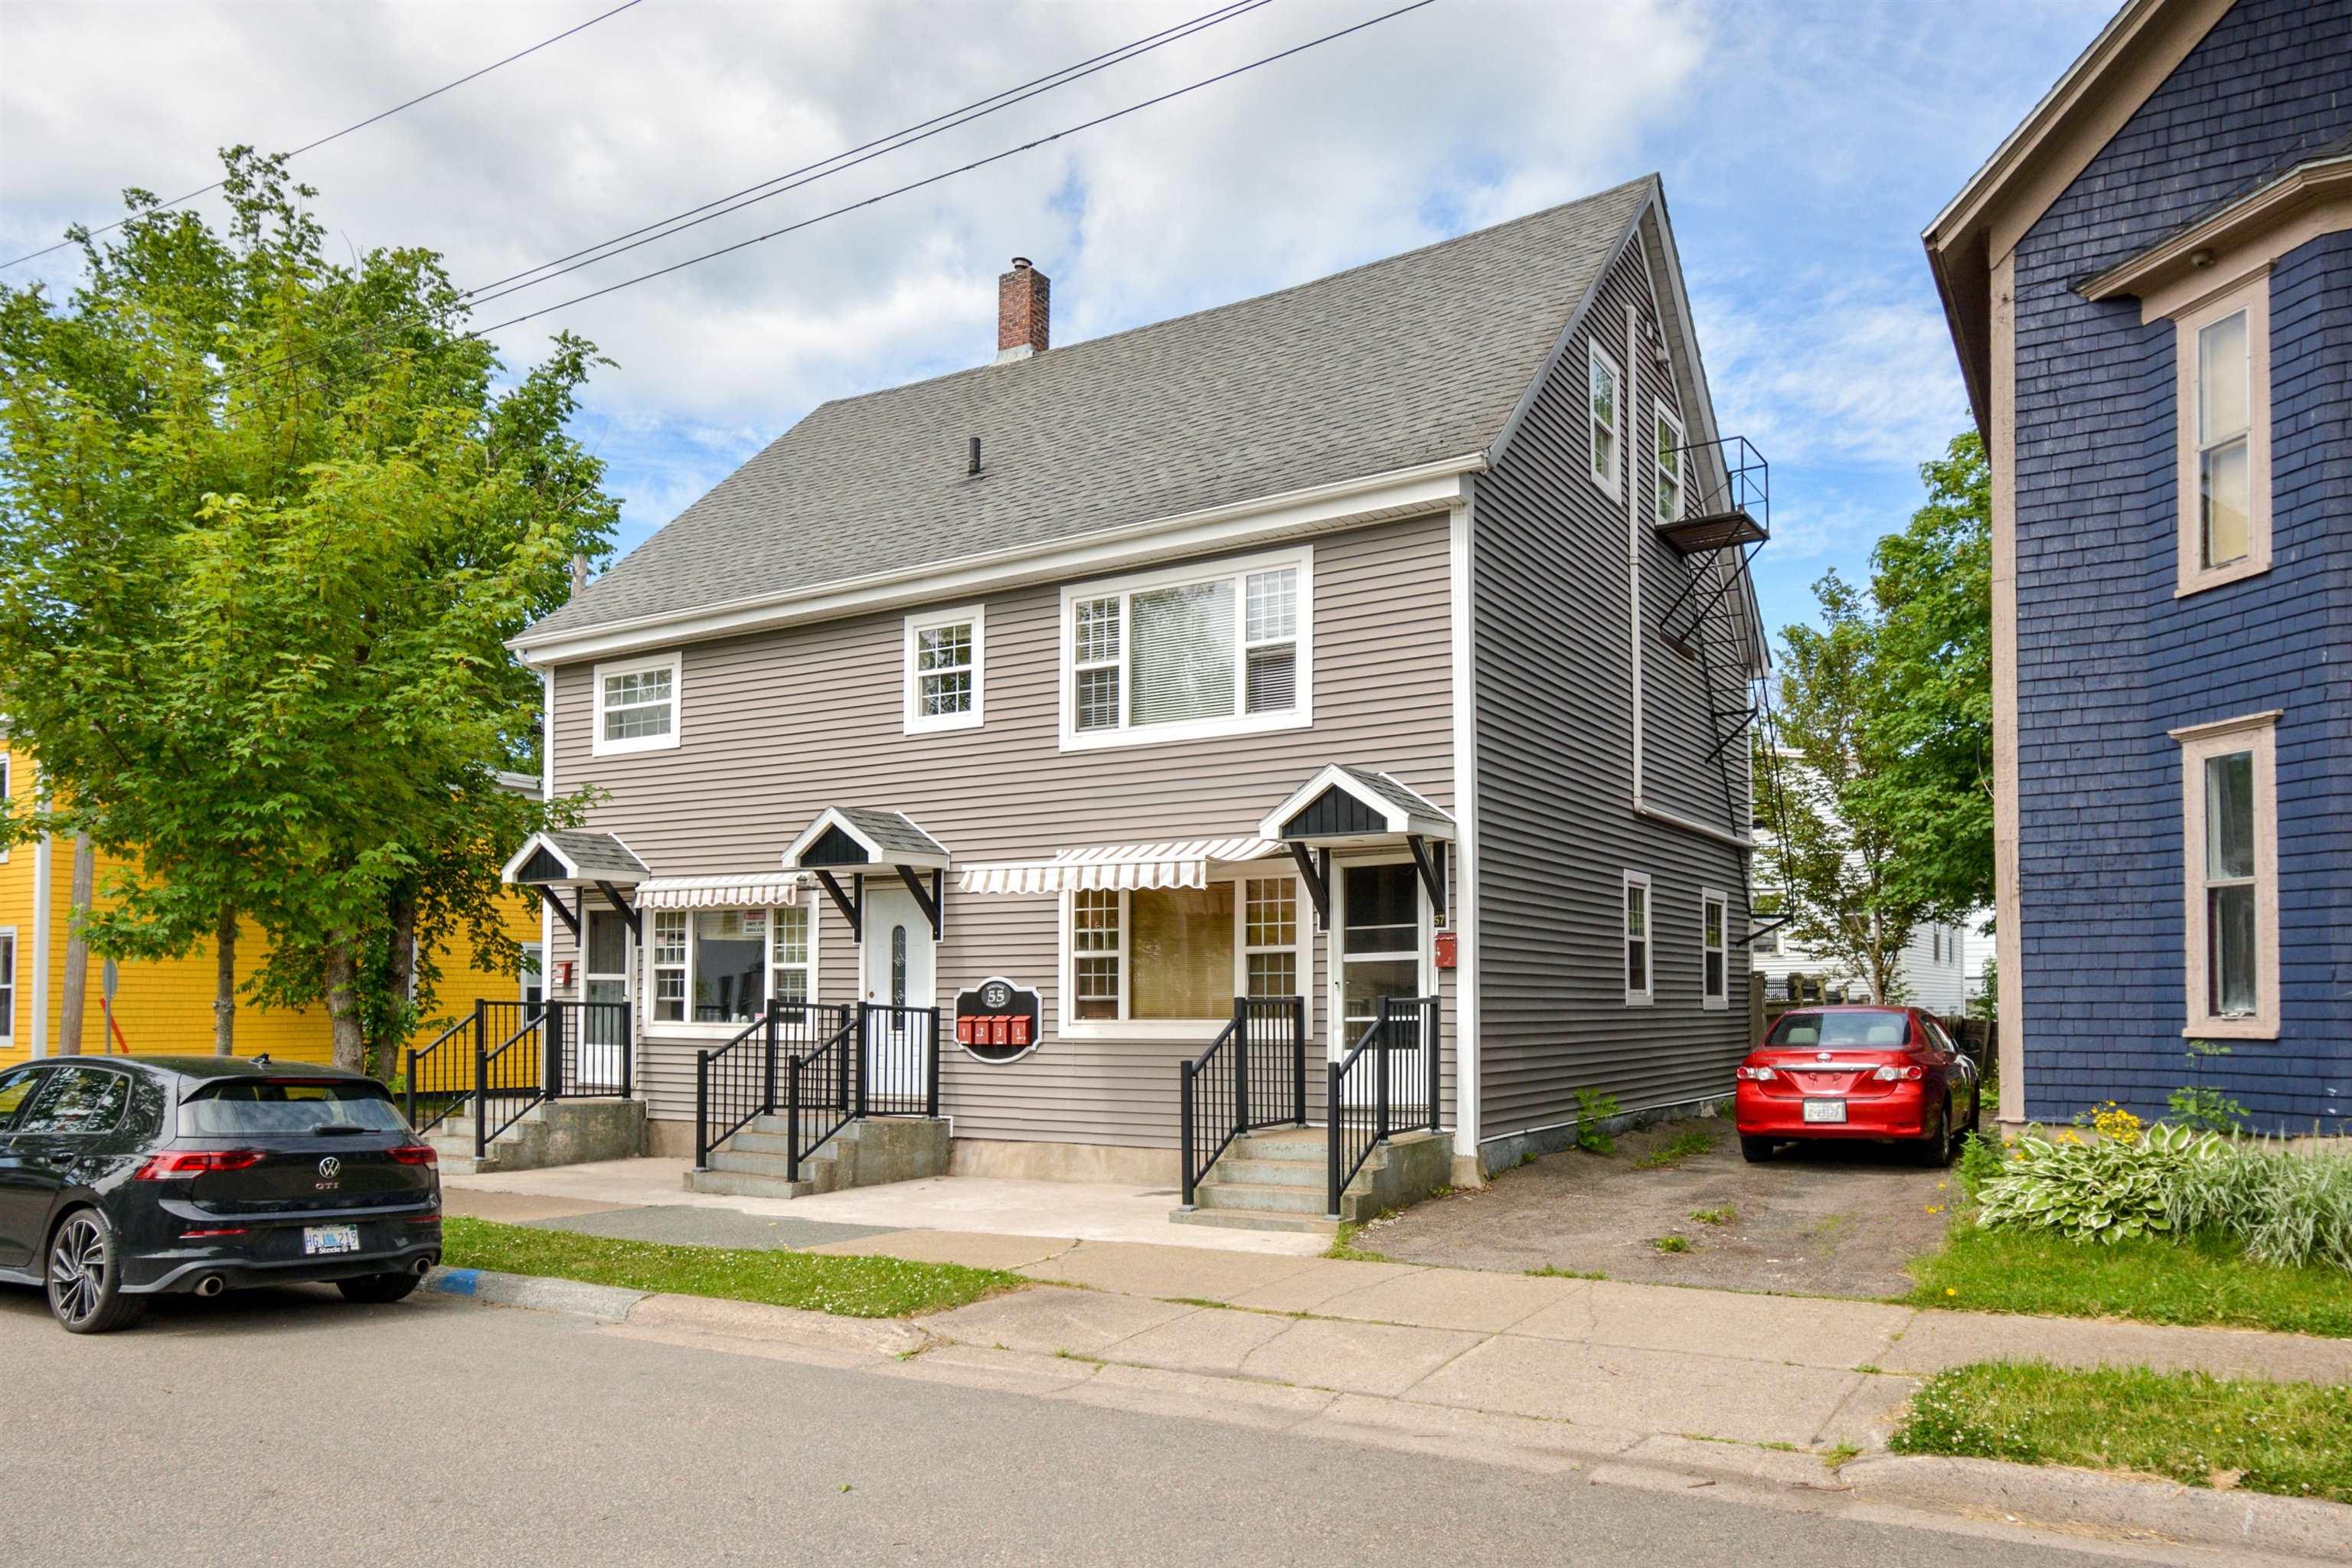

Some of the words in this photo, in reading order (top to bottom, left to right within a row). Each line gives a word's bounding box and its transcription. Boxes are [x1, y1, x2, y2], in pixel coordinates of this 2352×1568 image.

[1433, 914, 1446, 926] 57
[988, 990, 1004, 1002] 55
[979, 1027, 984, 1037] 2
[998, 1027, 1002, 1037] 3
[1016, 1027, 1021, 1036] 4
[305, 1233, 325, 1247] HGJ
[338, 1231, 357, 1245] 219
